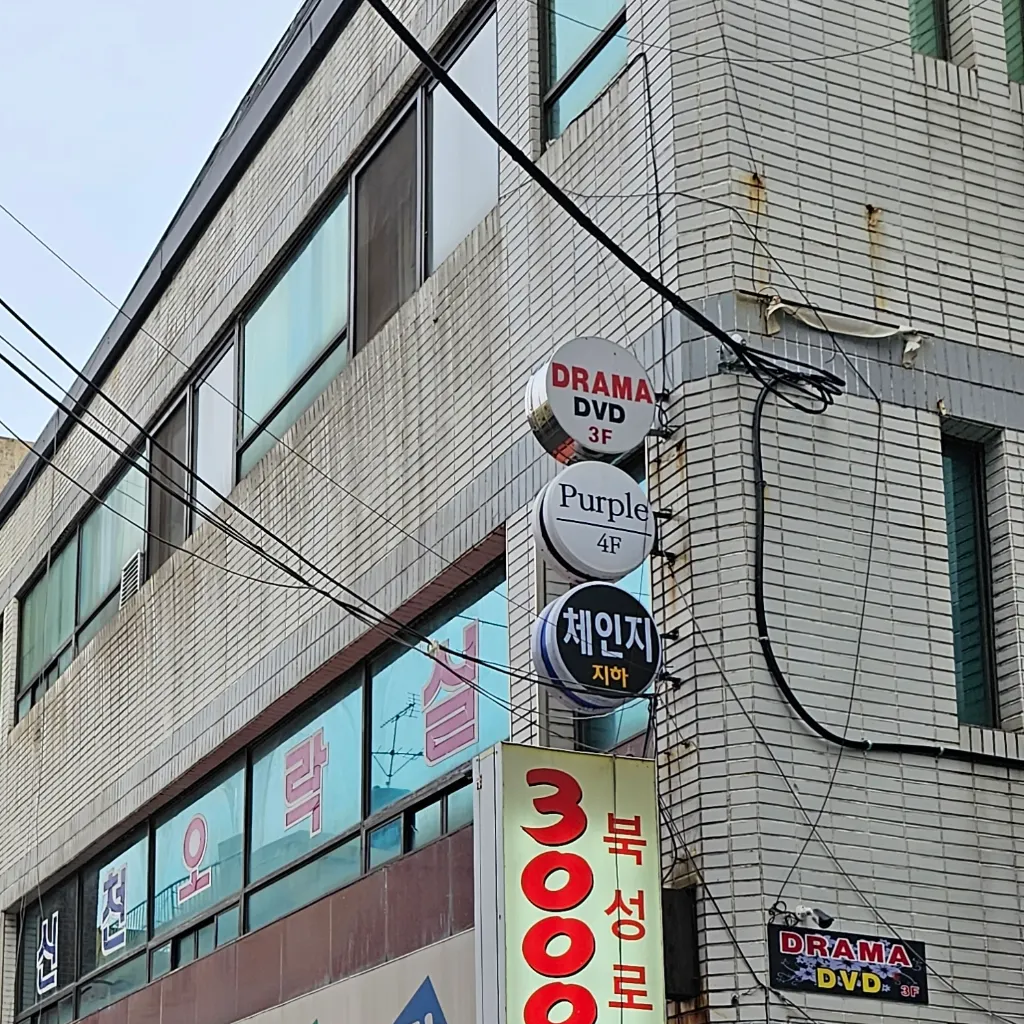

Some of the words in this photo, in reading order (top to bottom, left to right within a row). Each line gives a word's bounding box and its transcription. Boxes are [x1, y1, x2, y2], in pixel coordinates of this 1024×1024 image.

[551, 362, 653, 404] DRAMA
[574, 396, 625, 424] DVD
[588, 426, 613, 445] 3F
[559, 483, 649, 523] Purple
[597, 532, 622, 555] 4F
[563, 606, 653, 663] 체인지
[592, 663, 629, 688] 지하
[779, 930, 911, 967] DRAMA
[816, 967, 882, 995] DVD
[900, 983, 920, 998] 3F
